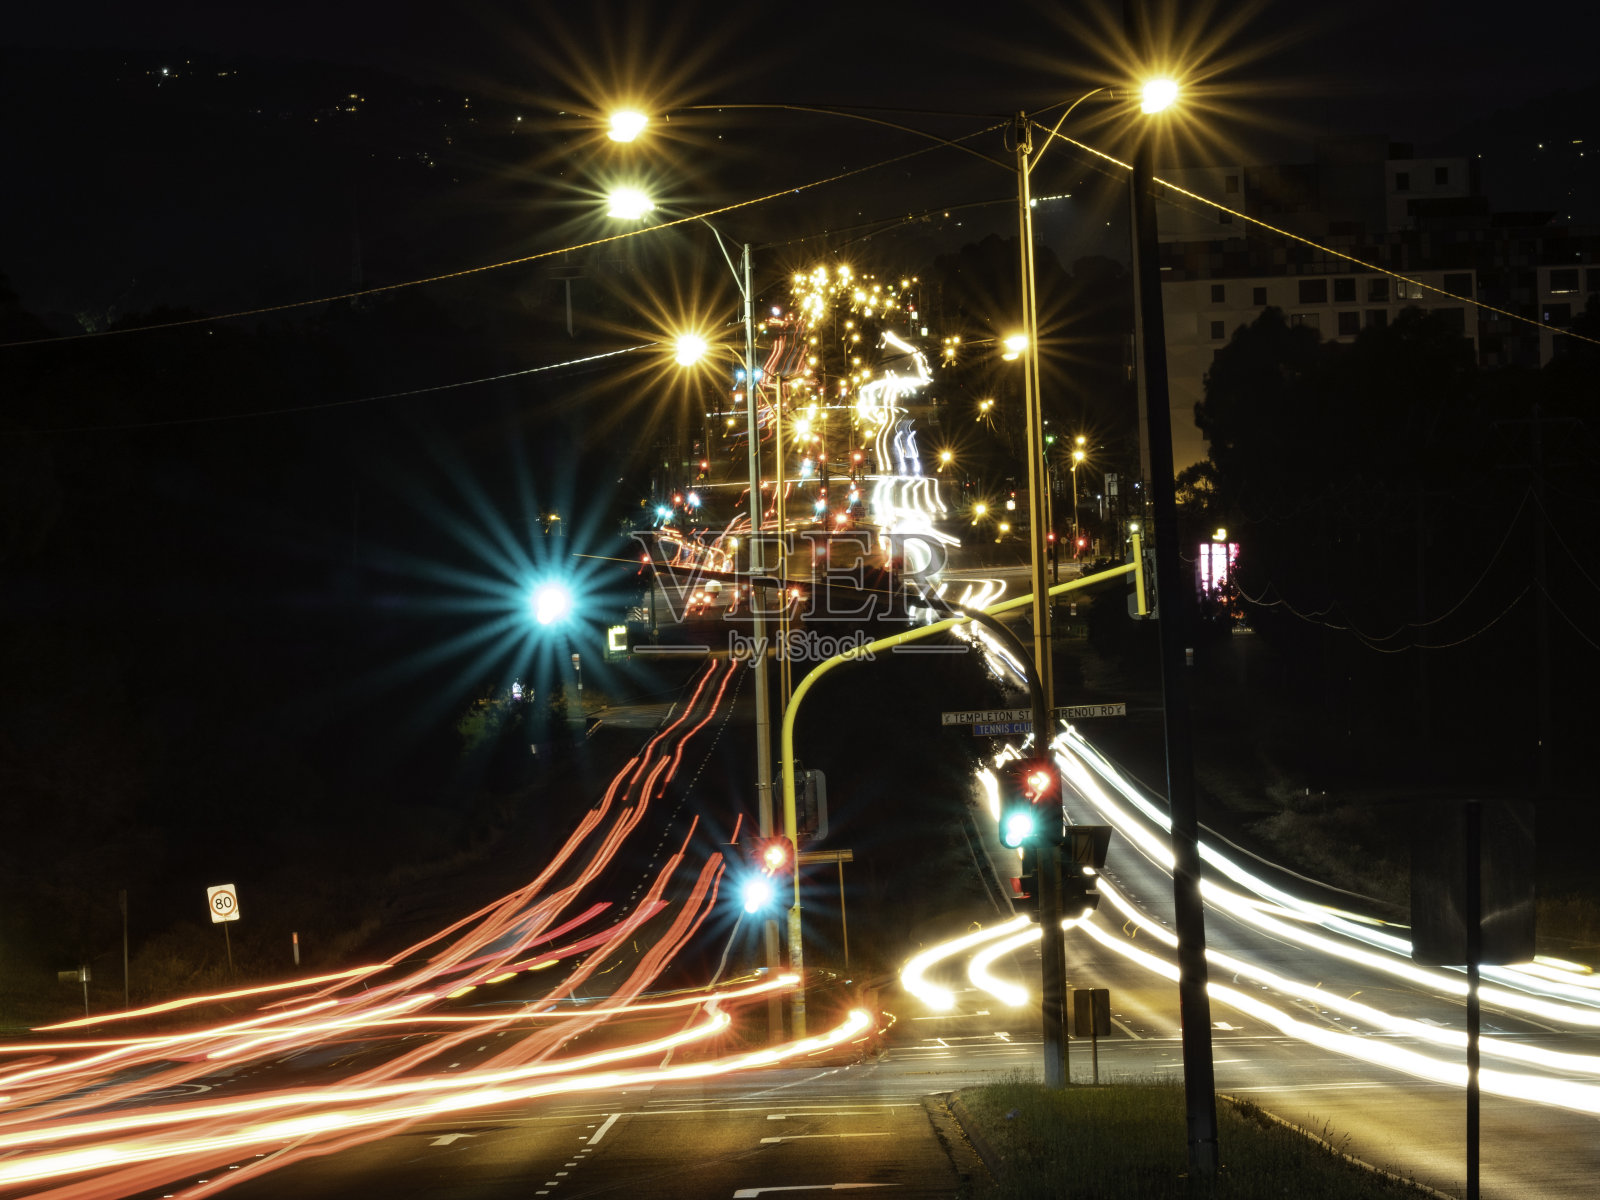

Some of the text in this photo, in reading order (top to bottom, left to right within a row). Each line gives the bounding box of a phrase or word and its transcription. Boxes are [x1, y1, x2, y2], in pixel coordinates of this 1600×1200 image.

[953, 710, 1031, 723] TEMPLETON ST
[1061, 706, 1114, 718] RENOU RD
[979, 723, 1010, 734] TENNIS
[215, 896, 232, 910] 80
